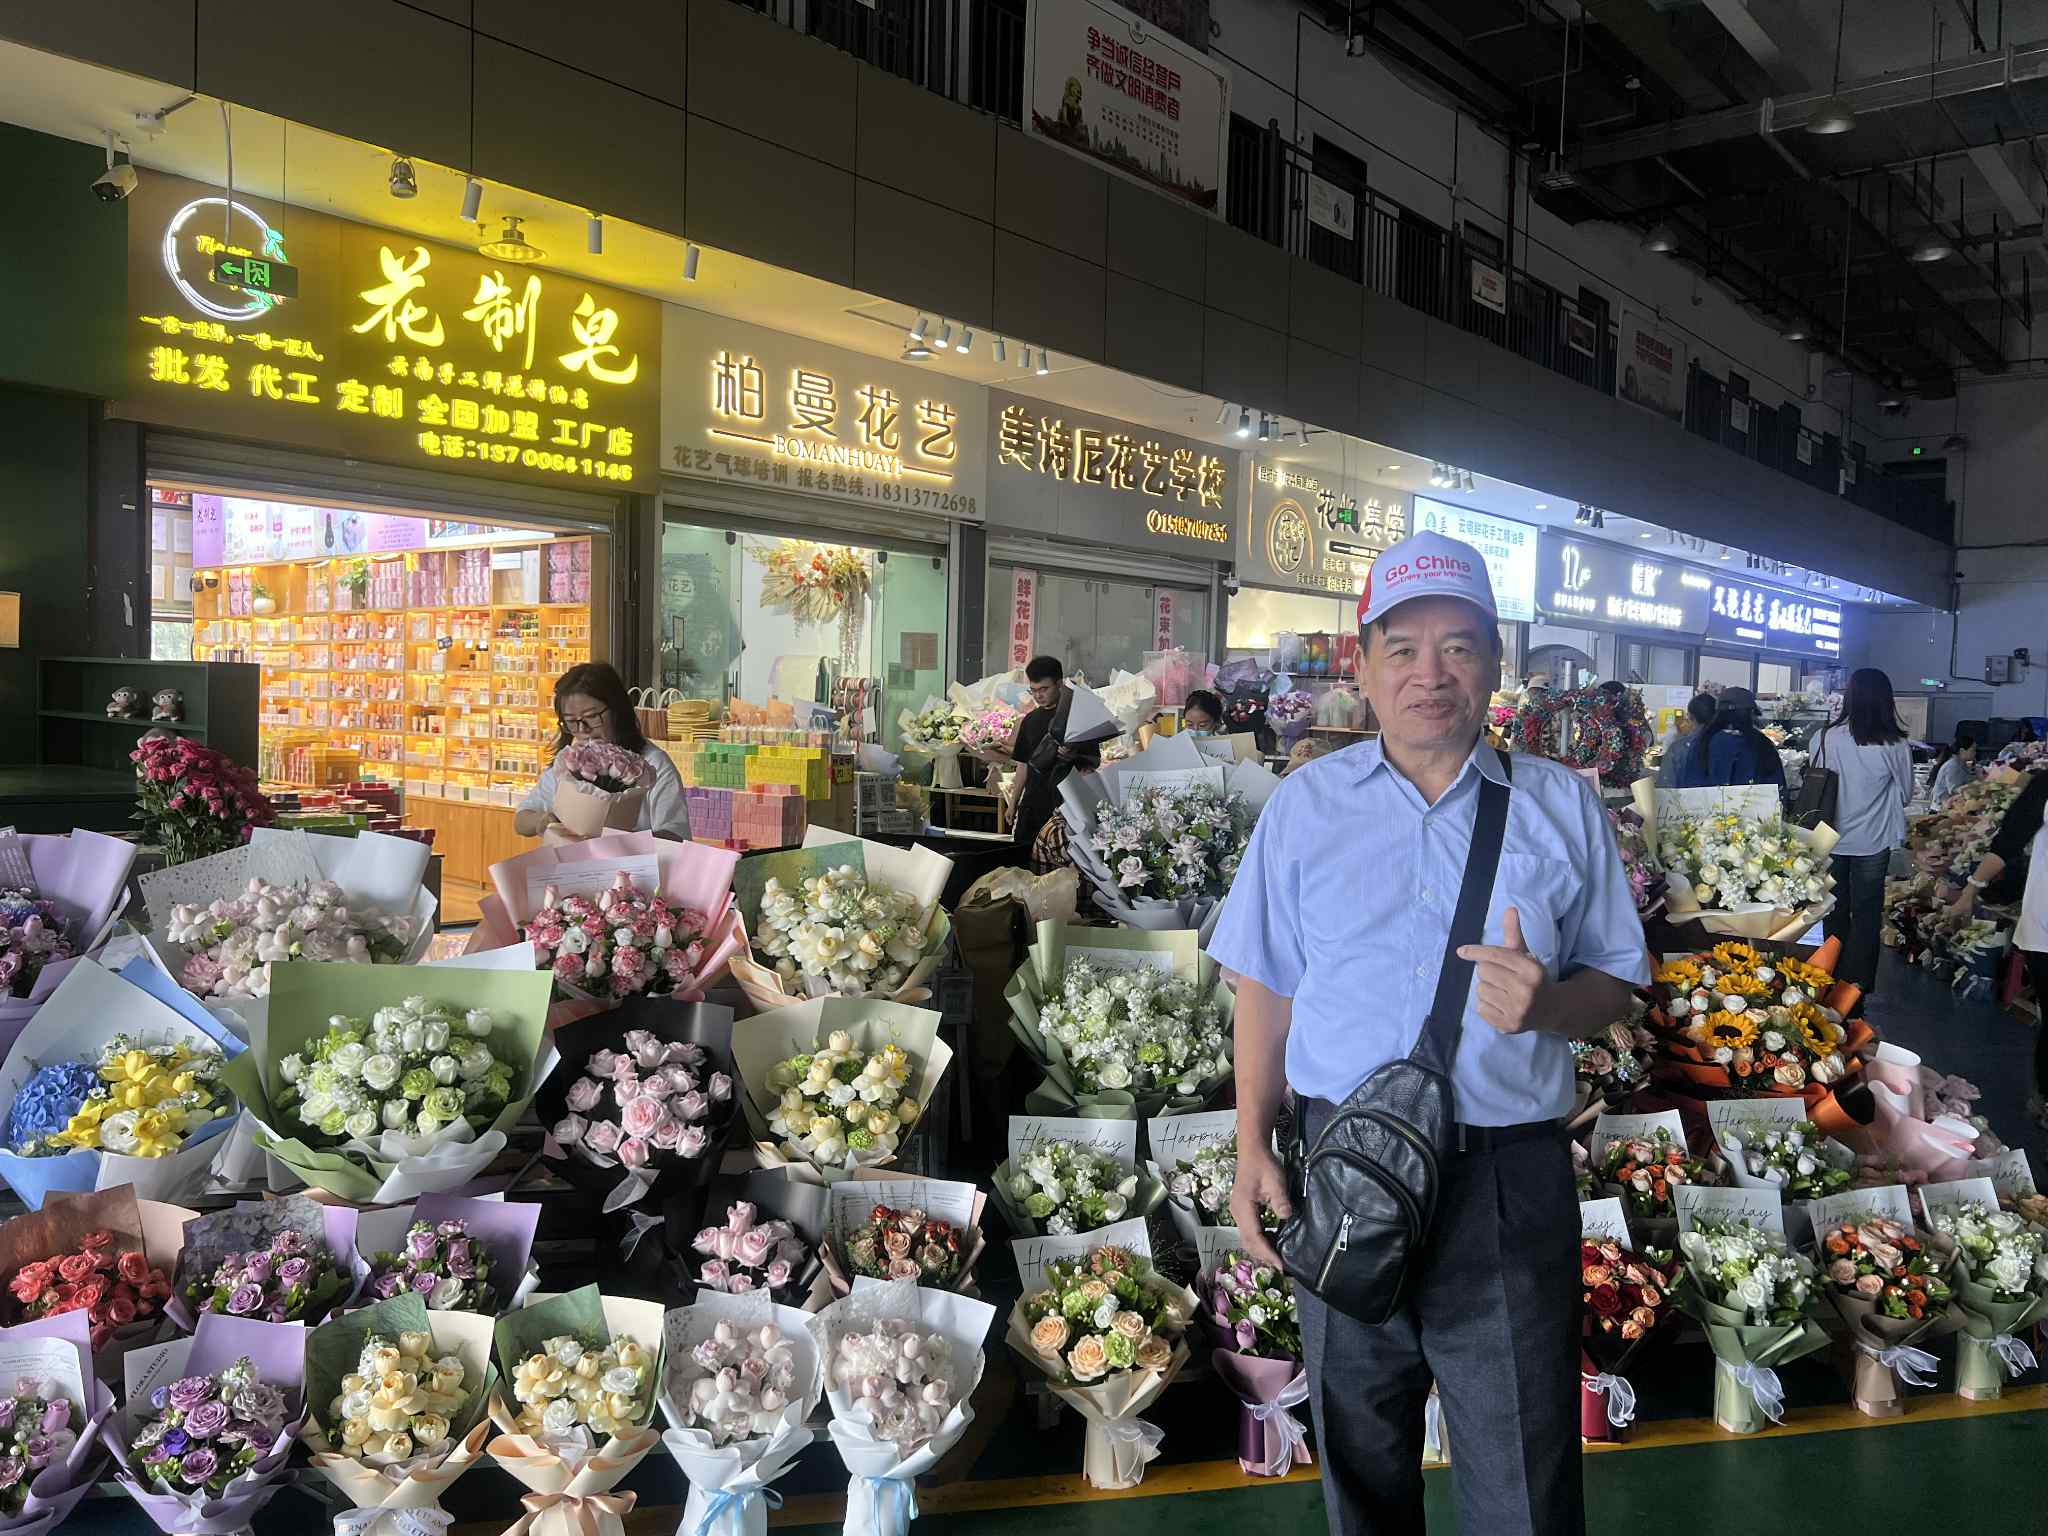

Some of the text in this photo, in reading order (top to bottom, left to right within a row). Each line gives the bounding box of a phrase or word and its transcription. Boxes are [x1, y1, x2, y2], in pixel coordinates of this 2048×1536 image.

[352, 246, 639, 384] 花制皂
[149, 346, 633, 457] 批发 代工 定制 全国加盟 工厂店
[711, 350, 958, 462] 柏曼花艺
[672, 444, 977, 514] 花艺气球培训 报名热线:18313772698
[998, 405, 1227, 510] 美诗尼花艺学校
[1385, 555, 1472, 582] Go China
[1089, 1127, 1127, 1157] day
[1739, 1197, 1773, 1226] day
